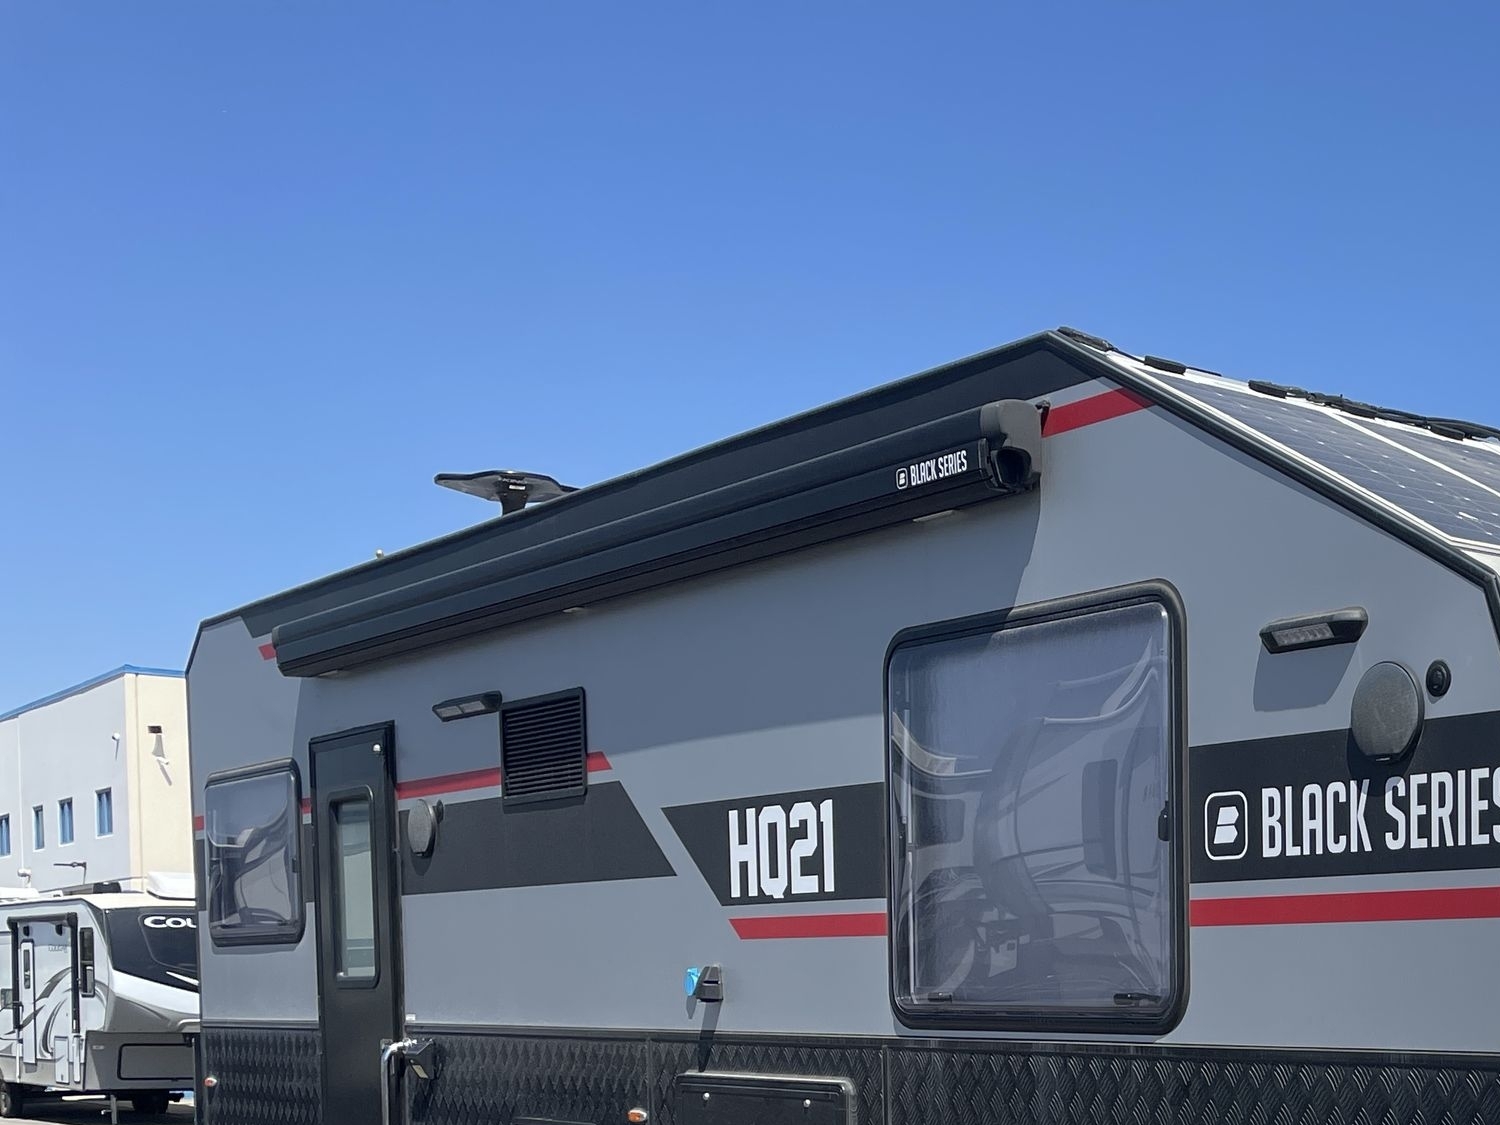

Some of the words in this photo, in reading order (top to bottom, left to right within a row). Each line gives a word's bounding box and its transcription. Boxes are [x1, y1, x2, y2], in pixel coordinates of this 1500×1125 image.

[910, 459, 937, 486] BLACK
[938, 450, 967, 478] SERIES
[729, 799, 834, 898] HQ21
[1262, 779, 1372, 857] BLACK
